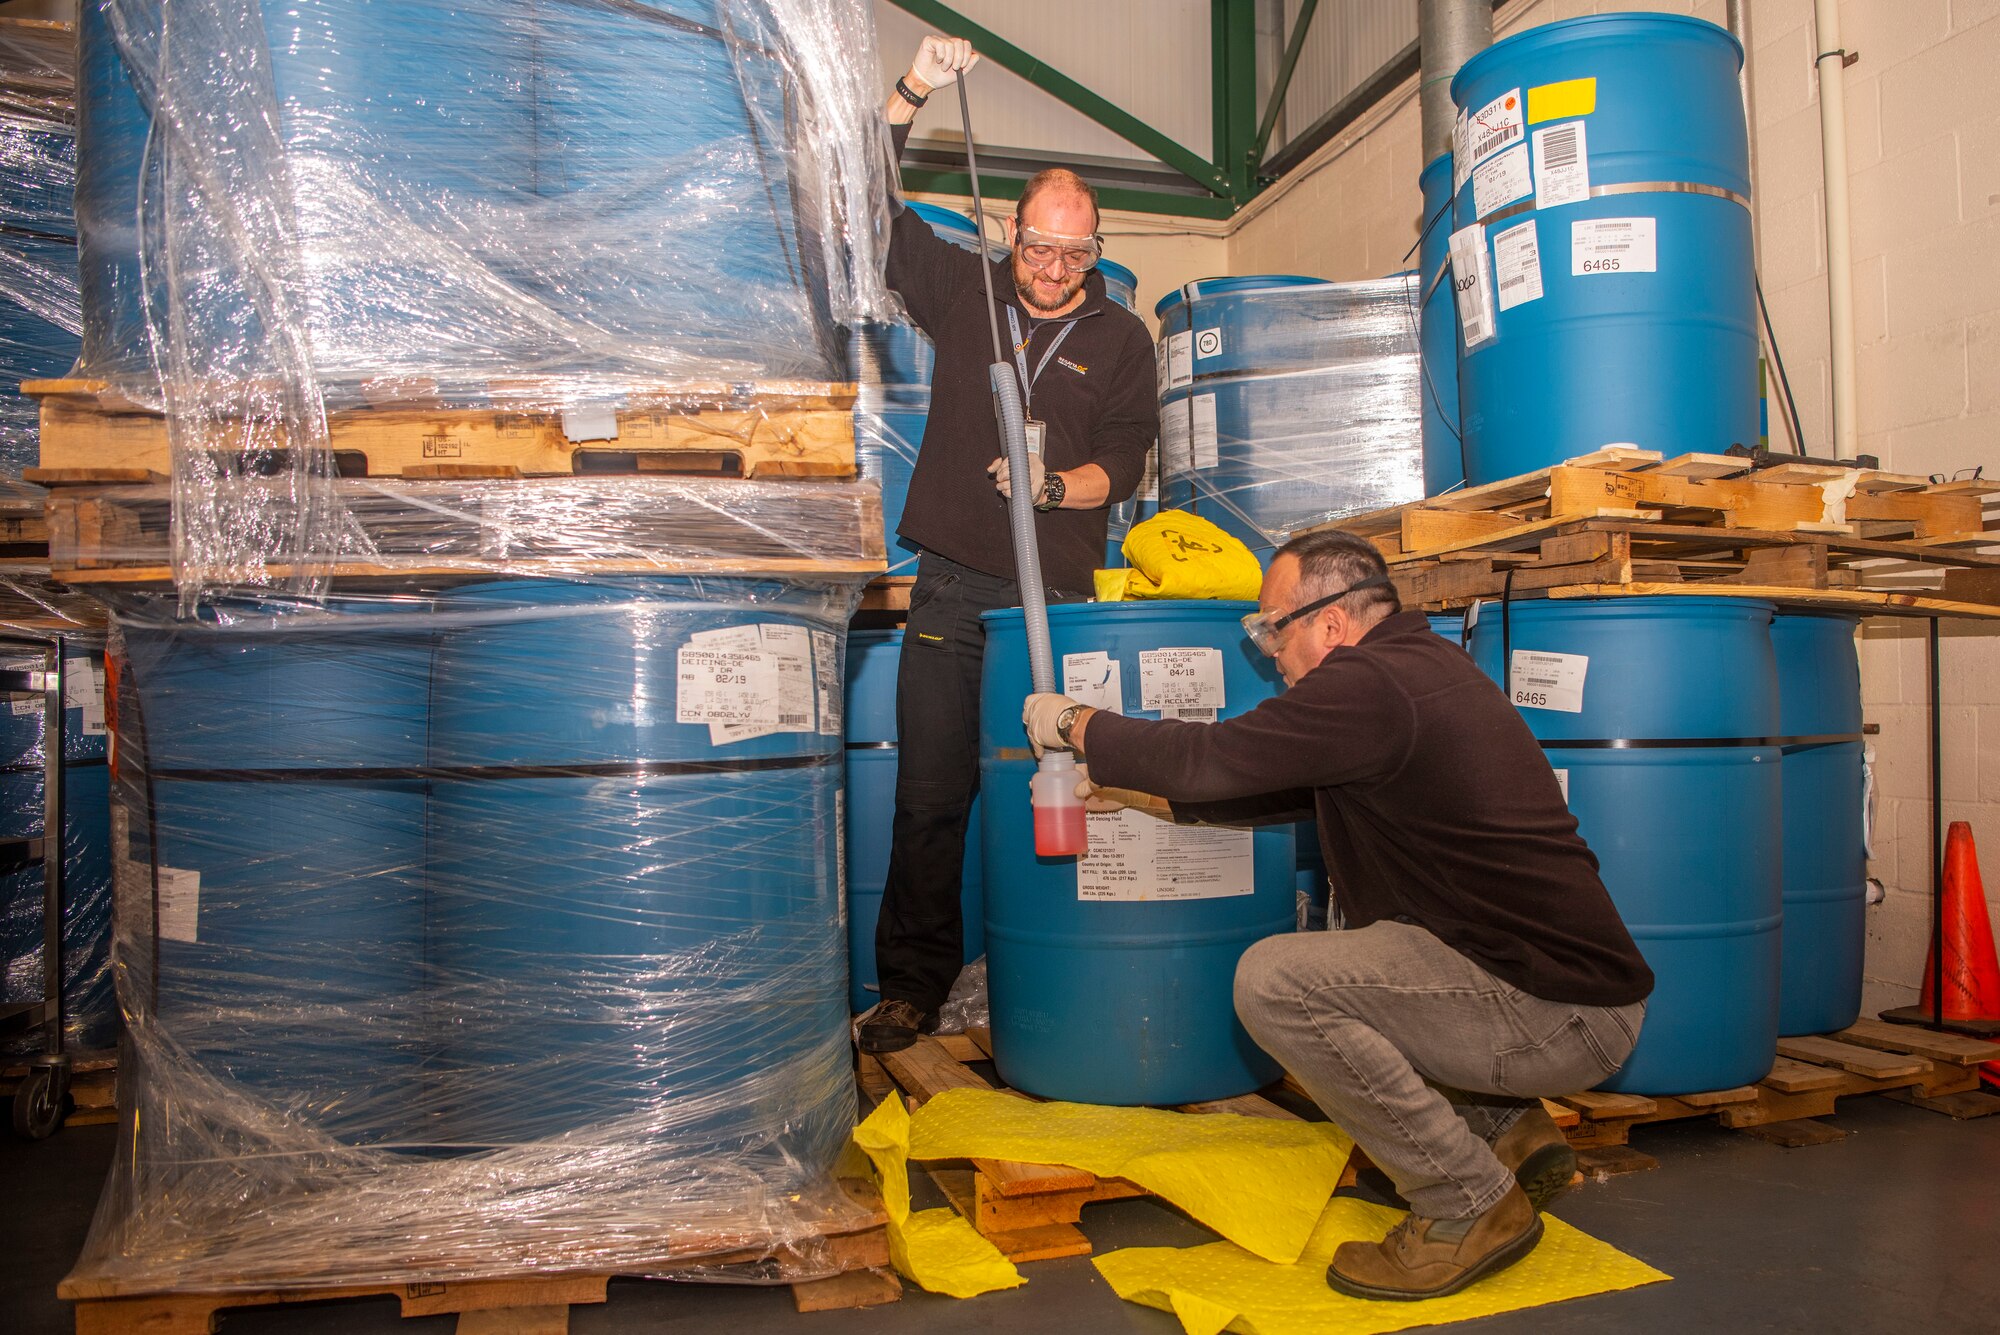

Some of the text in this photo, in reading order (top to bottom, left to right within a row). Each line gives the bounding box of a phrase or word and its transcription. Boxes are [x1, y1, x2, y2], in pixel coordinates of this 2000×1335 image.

[1584, 259, 1620, 272] 6465
[682, 659, 744, 667] DEICING-DE
[1170, 668, 1195, 676] 04/18
[715, 674, 747, 684] 02/19
[1516, 691, 1547, 706] 6465
